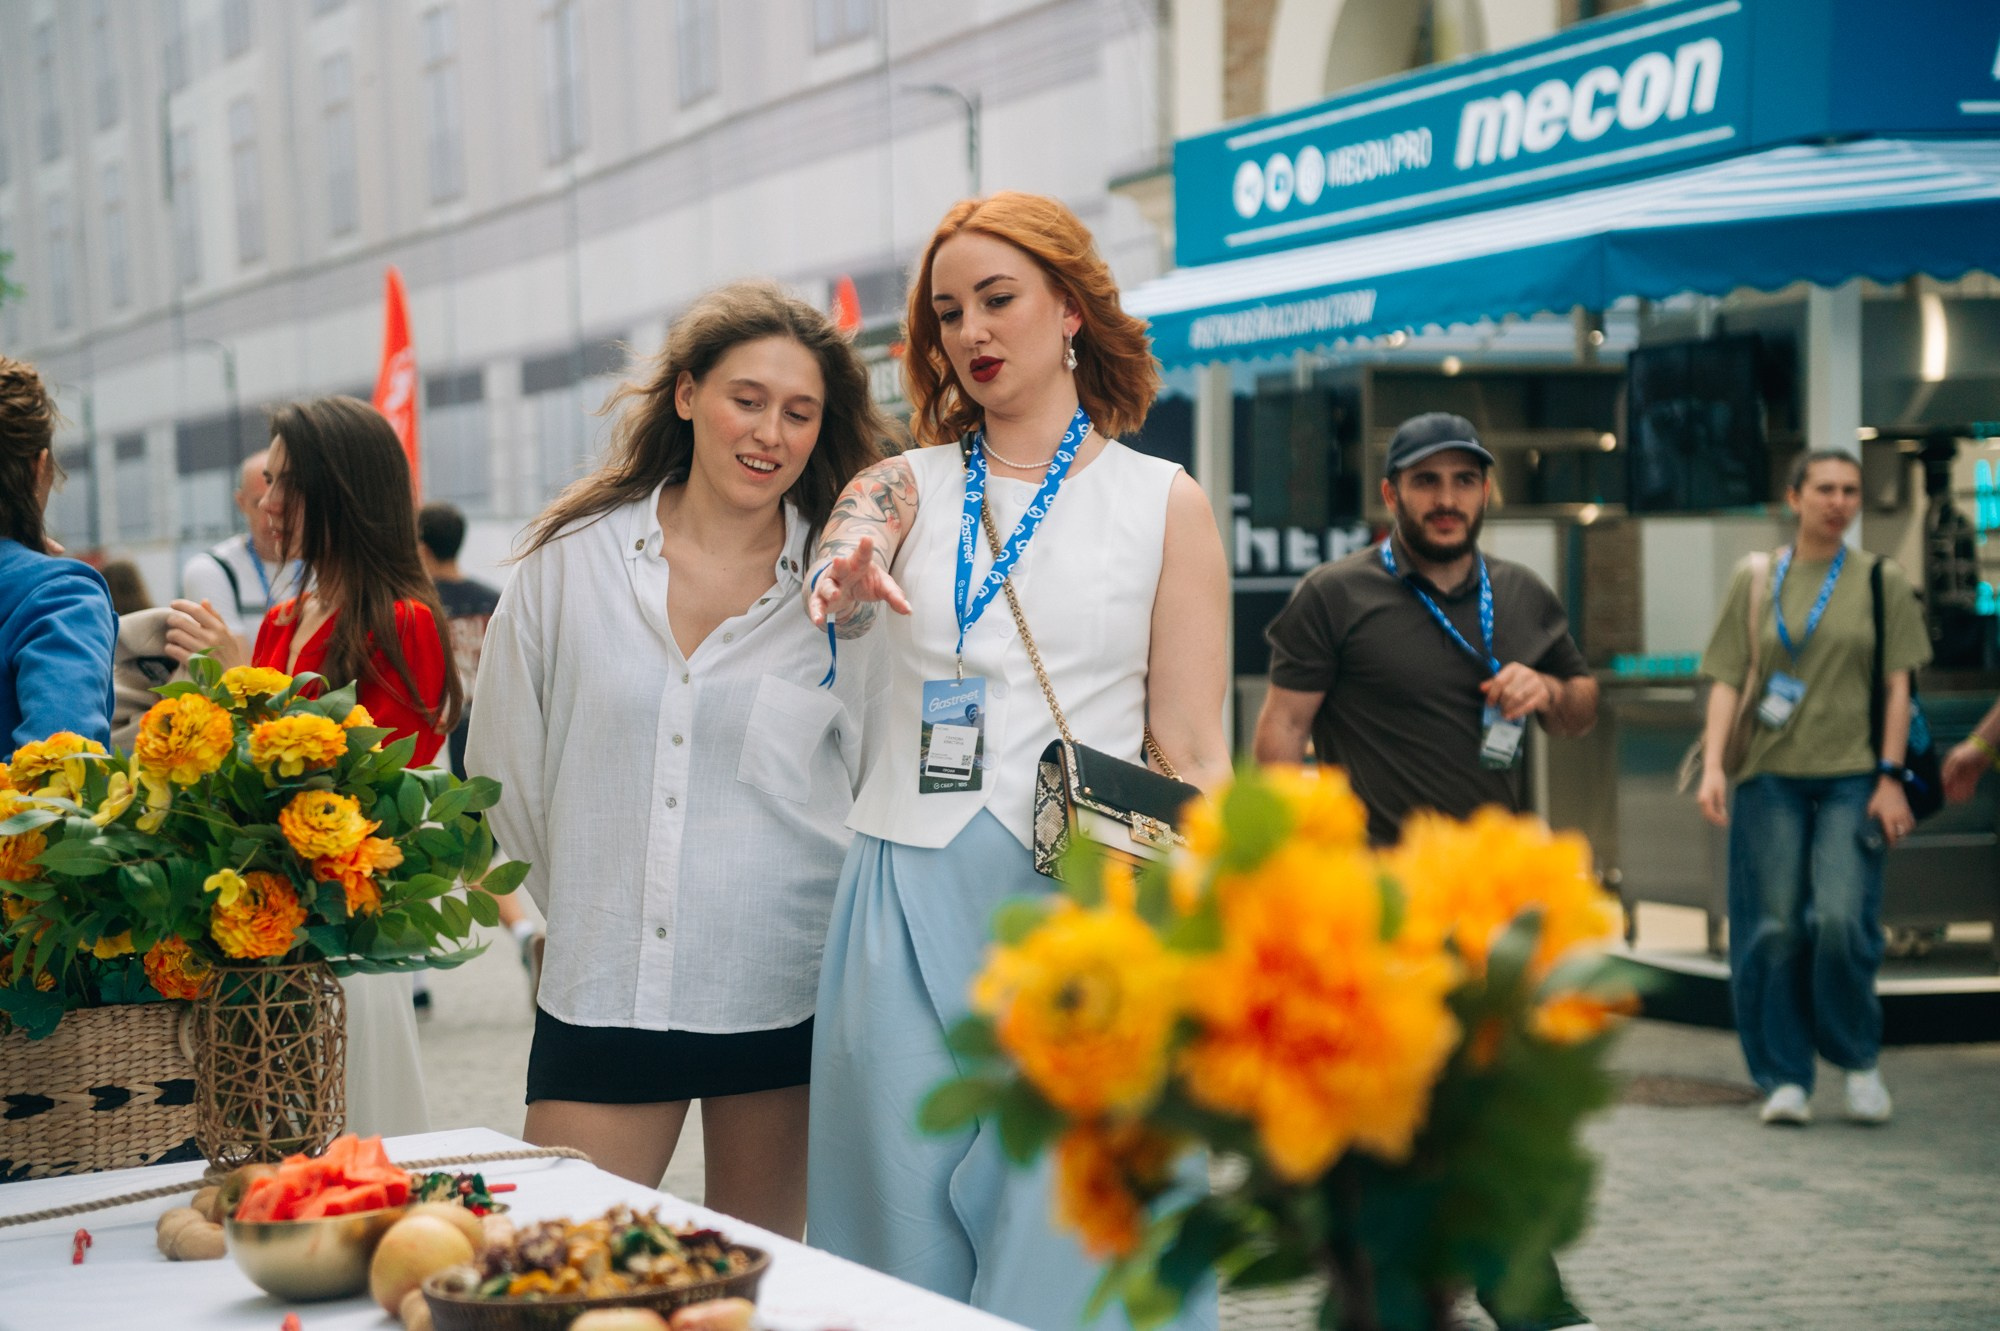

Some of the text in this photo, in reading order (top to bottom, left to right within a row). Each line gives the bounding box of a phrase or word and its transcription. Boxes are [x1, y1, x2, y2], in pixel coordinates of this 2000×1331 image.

[1326, 37, 1723, 188] MECON.PRO mecon
[962, 513, 975, 564] Gastreet
[928, 689, 980, 713] Gastreet
